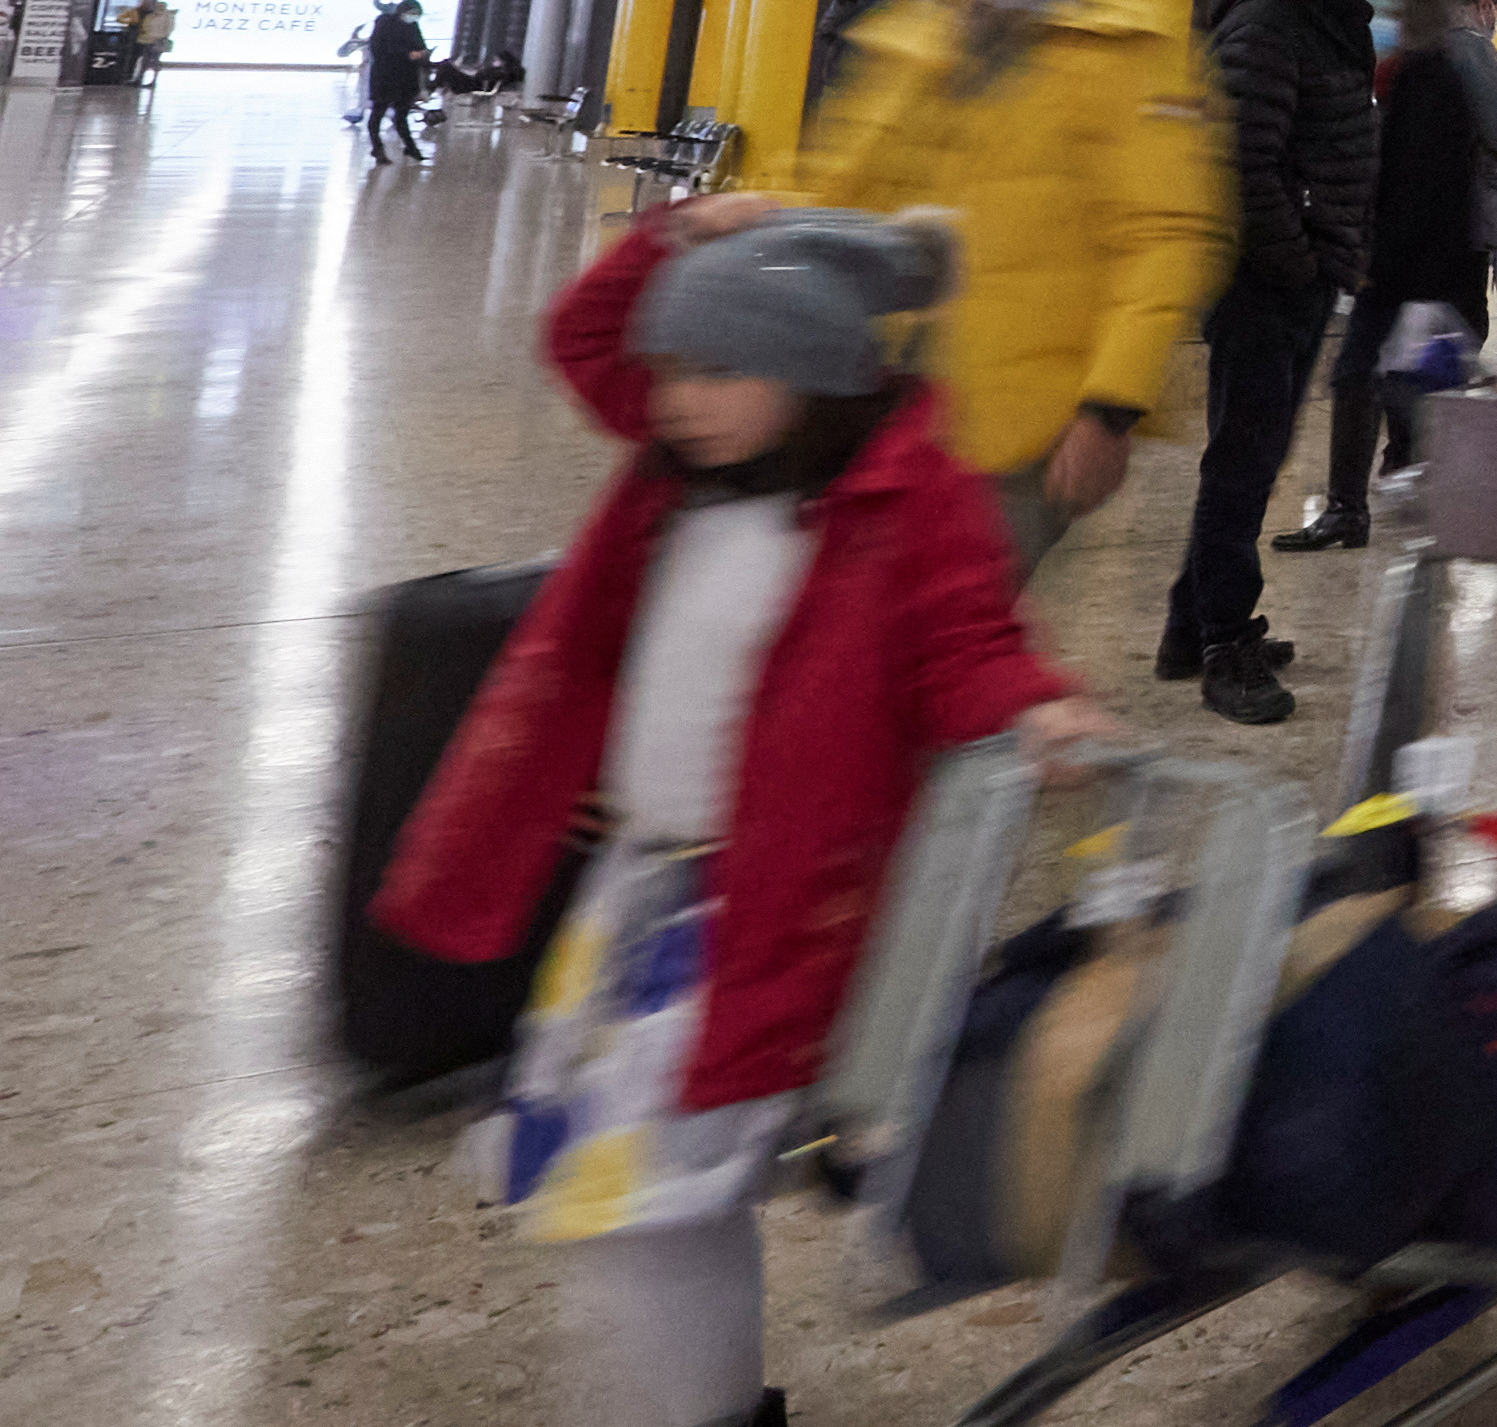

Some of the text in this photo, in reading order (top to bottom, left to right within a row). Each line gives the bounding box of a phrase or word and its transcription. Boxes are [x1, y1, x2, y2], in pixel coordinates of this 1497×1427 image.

[194, 1, 323, 15] MONTREUX
[192, 17, 315, 32] JAZZ CAFÉ
